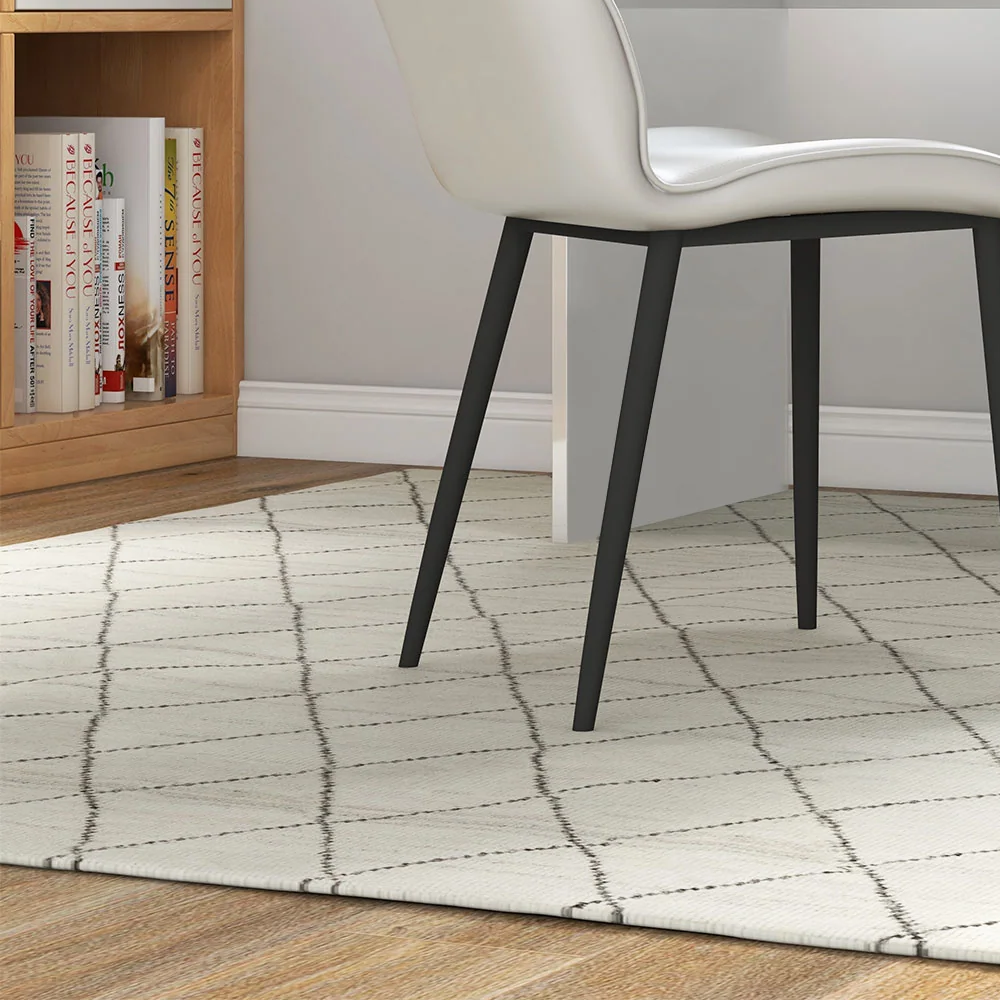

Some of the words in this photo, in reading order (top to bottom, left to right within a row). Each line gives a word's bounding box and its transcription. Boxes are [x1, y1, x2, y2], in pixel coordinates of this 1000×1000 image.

[65, 159, 76, 240] BECAUSE
[82, 159, 93, 239] BECAUSE
[192, 152, 201, 229] BECAUSE
[29, 284, 35, 294] OF
[65, 259, 76, 299] YOU
[82, 258, 93, 297] YOU
[164, 219, 175, 302] SENSE
[192, 247, 201, 286] YOU
